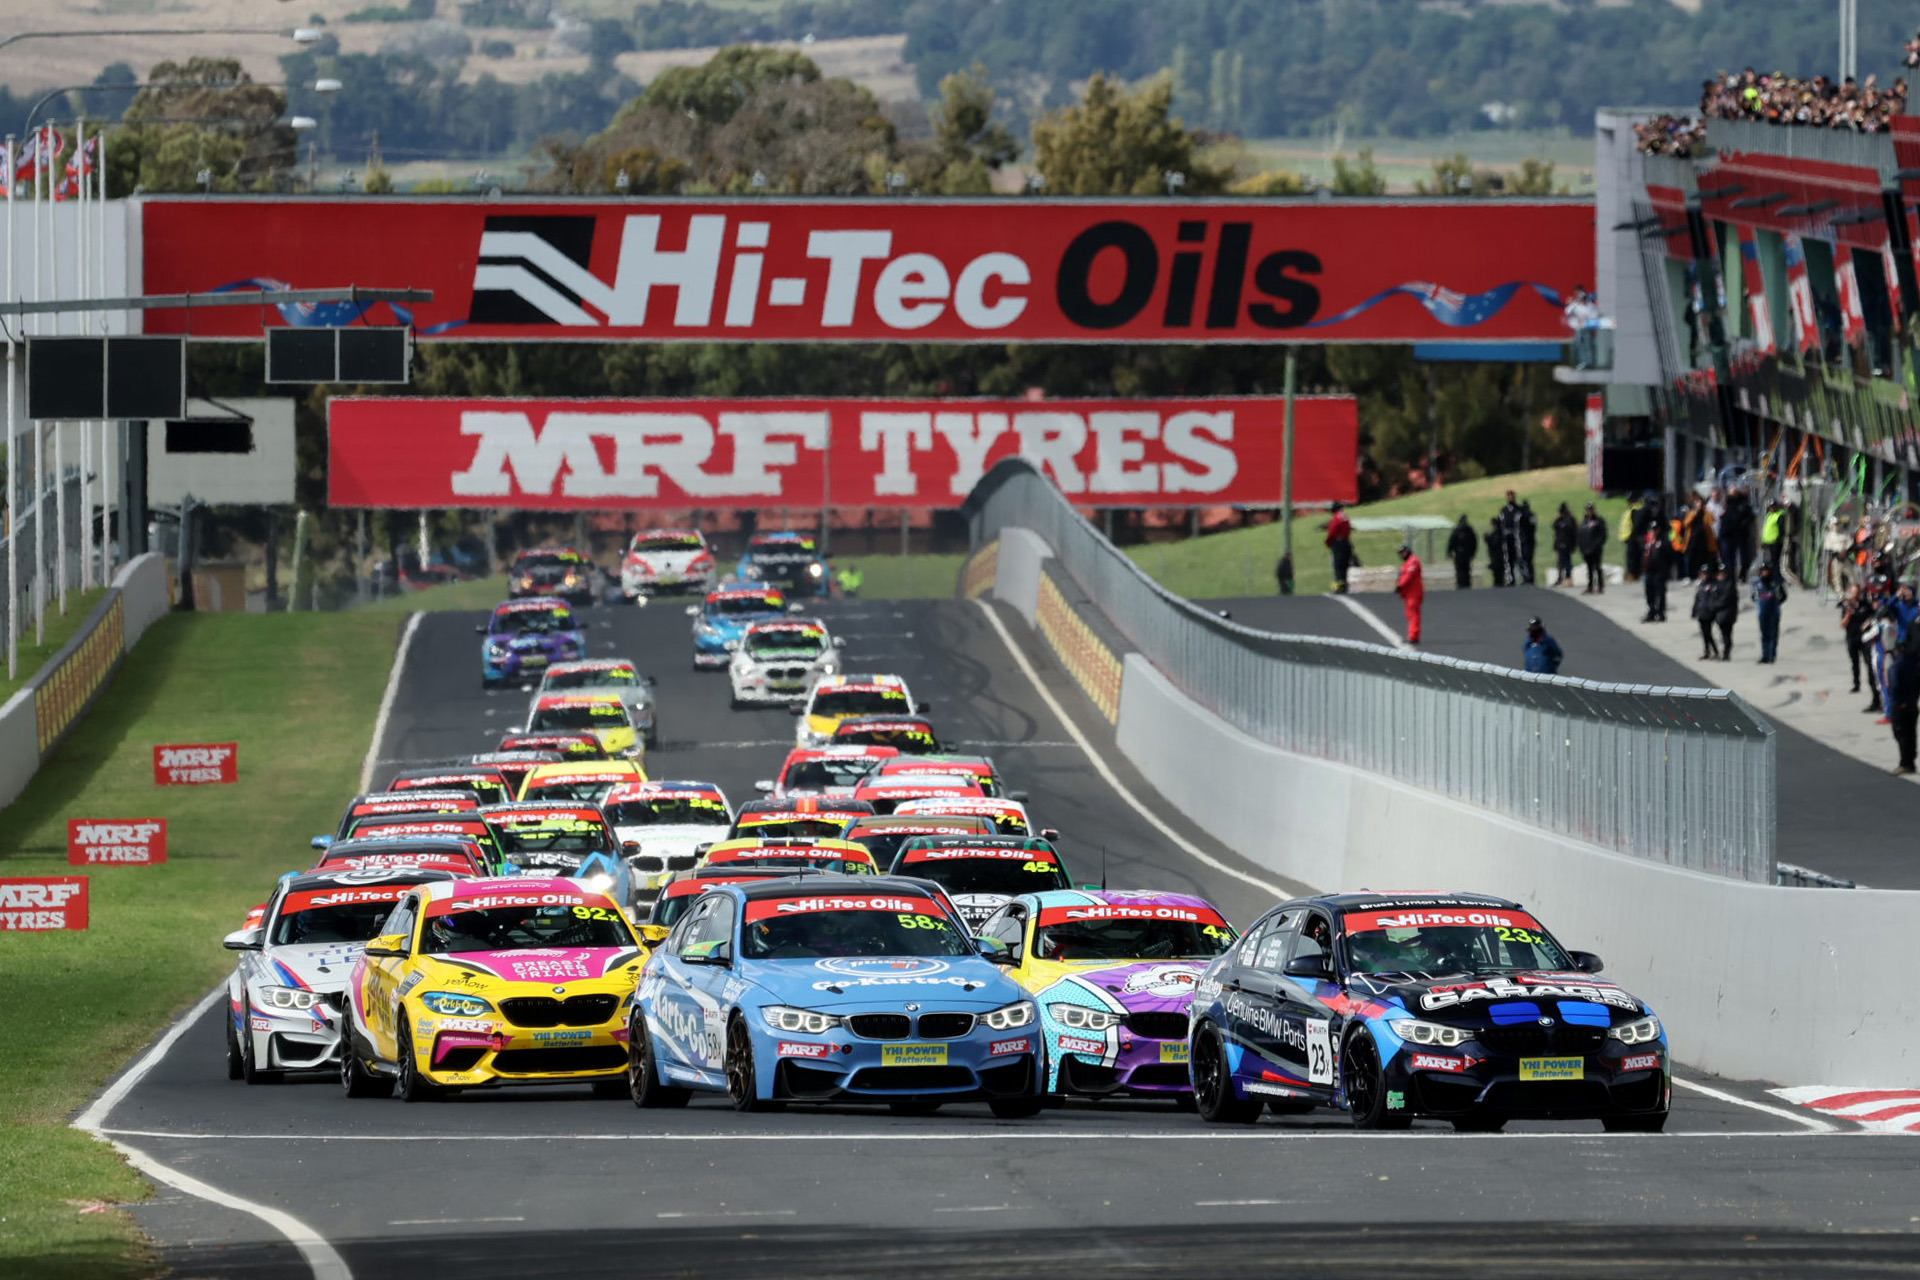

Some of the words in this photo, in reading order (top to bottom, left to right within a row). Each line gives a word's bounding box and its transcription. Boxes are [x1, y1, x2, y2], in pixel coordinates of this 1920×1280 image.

[609, 214, 1031, 330] Hi-Tec
[1056, 220, 1323, 330] Oils
[452, 411, 831, 497] MRF
[859, 411, 1238, 495] TYRES
[160, 748, 231, 768] MRF
[169, 768, 222, 782] TYRES
[75, 824, 160, 844] MRF
[86, 846, 149, 861] TYRES
[946, 850, 997, 858] Hi-Tec
[999, 850, 1034, 859] Oils
[330, 892, 393, 904] Hi-Tec
[473, 896, 539, 908] Hi-Tec
[541, 894, 584, 905] Oils
[800, 899, 867, 911] Hi-Tec
[870, 898, 914, 912] Oils
[1088, 907, 1153, 918] Hi-Tec
[1156, 908, 1198, 921] Oils
[1399, 913, 1466, 926] Hi-Tec
[1468, 913, 1512, 928] Oils
[512, 960, 582, 969] BREAST
[514, 966, 588, 974] CANCER
[516, 971, 589, 980] TRIALS
[439, 1019, 493, 1032] MRF
[1227, 992, 1260, 1028] Genuine
[1260, 1007, 1283, 1039] BMW
[1283, 1020, 1306, 1052] Parts
[554, 1031, 592, 1040] POWER
[780, 1043, 825, 1056] MRF
[884, 1046, 904, 1056] YHI
[906, 1046, 946, 1056] POWER
[992, 1039, 1027, 1053] MRF
[1061, 1037, 1102, 1054] MRF
[894, 1056, 938, 1065] Batteries
[1415, 1055, 1462, 1070] MRF
[1522, 1060, 1541, 1070] YHI
[1543, 1060, 1583, 1069] POWER
[1624, 1055, 1657, 1070] MRF
[1532, 1070, 1574, 1078] Batteries
